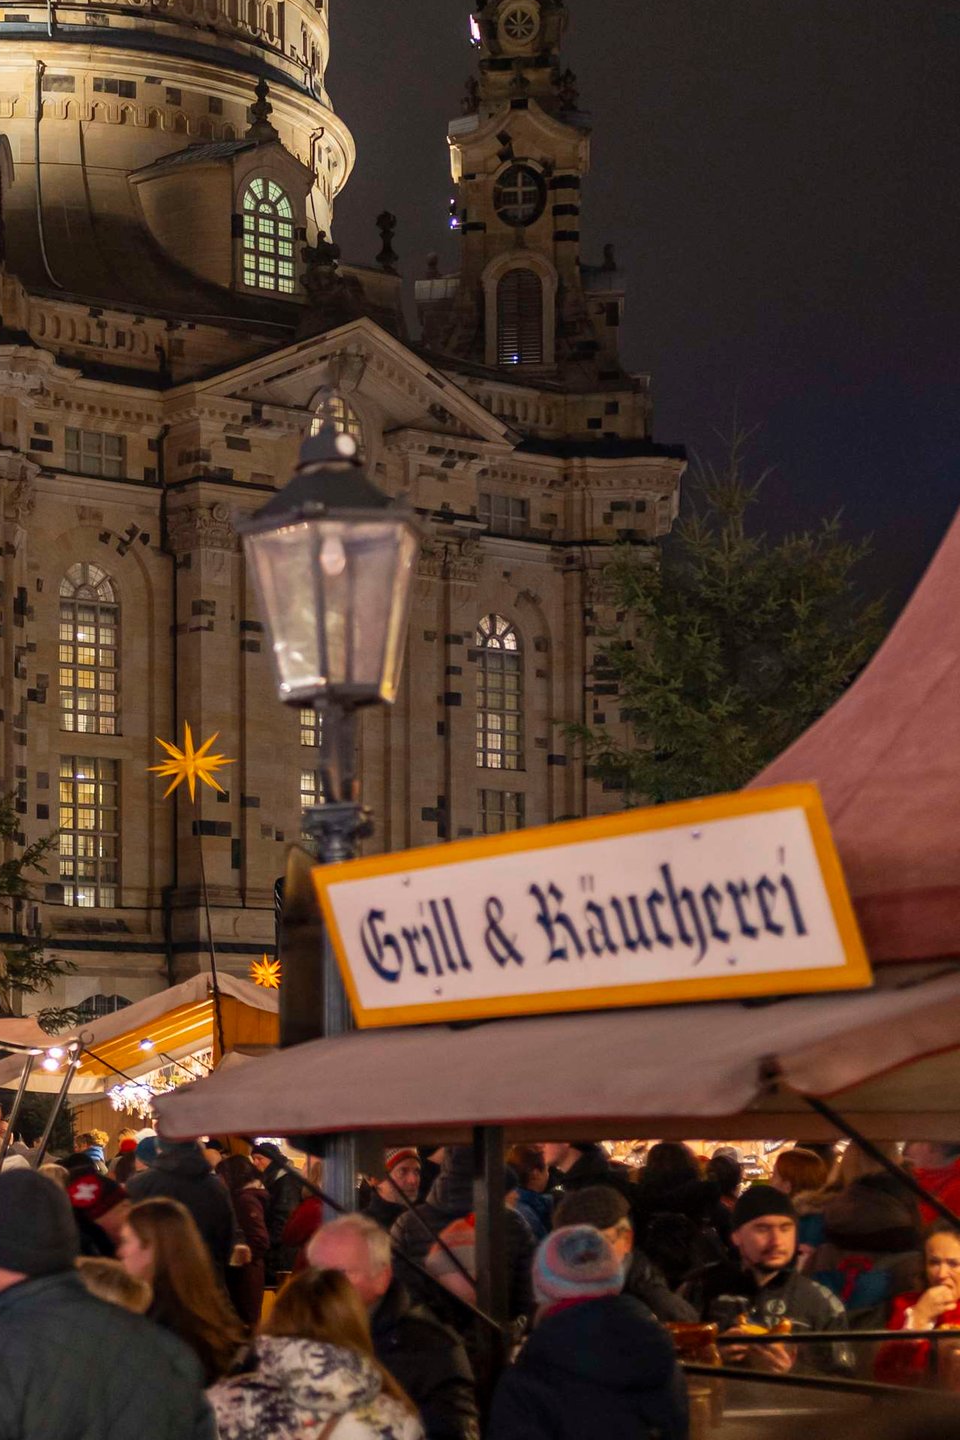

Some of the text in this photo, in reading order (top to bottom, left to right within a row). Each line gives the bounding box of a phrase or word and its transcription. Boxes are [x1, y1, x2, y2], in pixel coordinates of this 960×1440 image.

[359, 846, 808, 984] Grill & Räucherei
